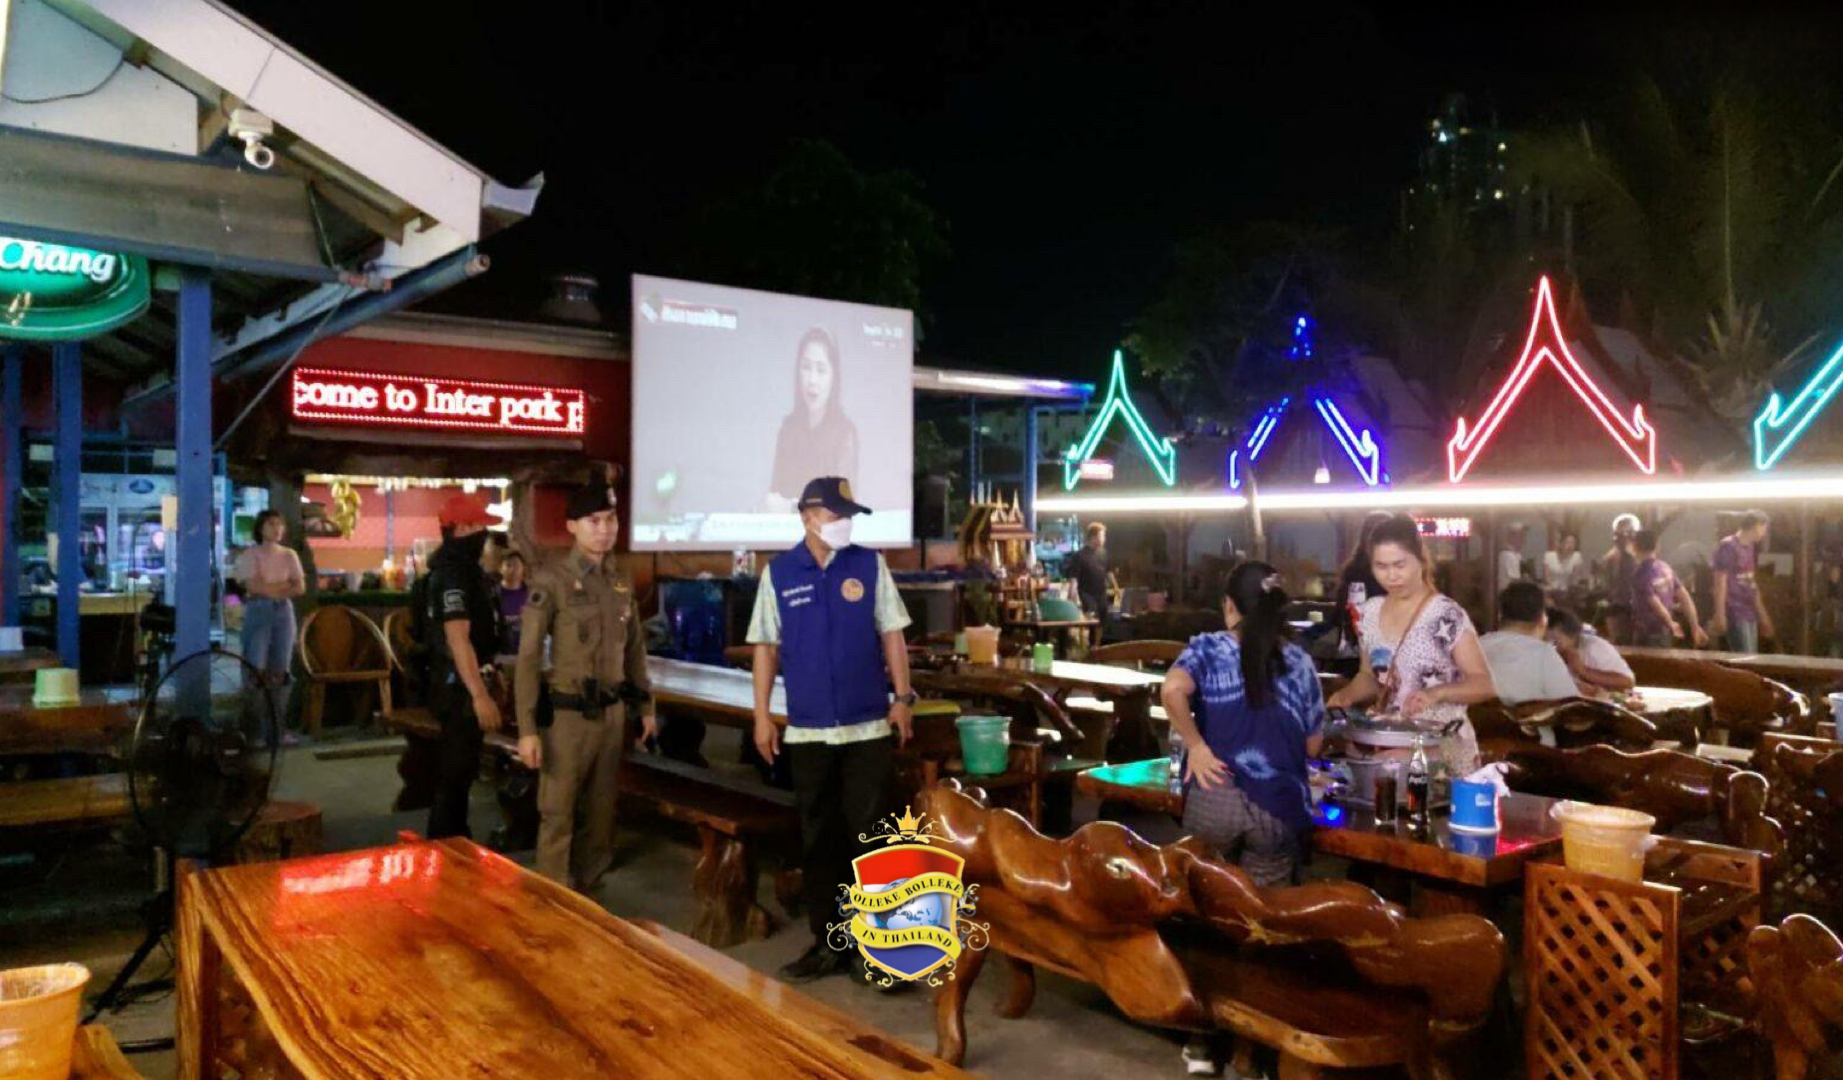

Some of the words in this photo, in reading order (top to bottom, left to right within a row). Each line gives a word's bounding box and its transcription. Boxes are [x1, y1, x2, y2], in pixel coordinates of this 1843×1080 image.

[0, 238, 116, 282] Chang
[384, 383, 417, 411] to
[424, 384, 495, 416] Inter
[500, 392, 562, 425] pork
